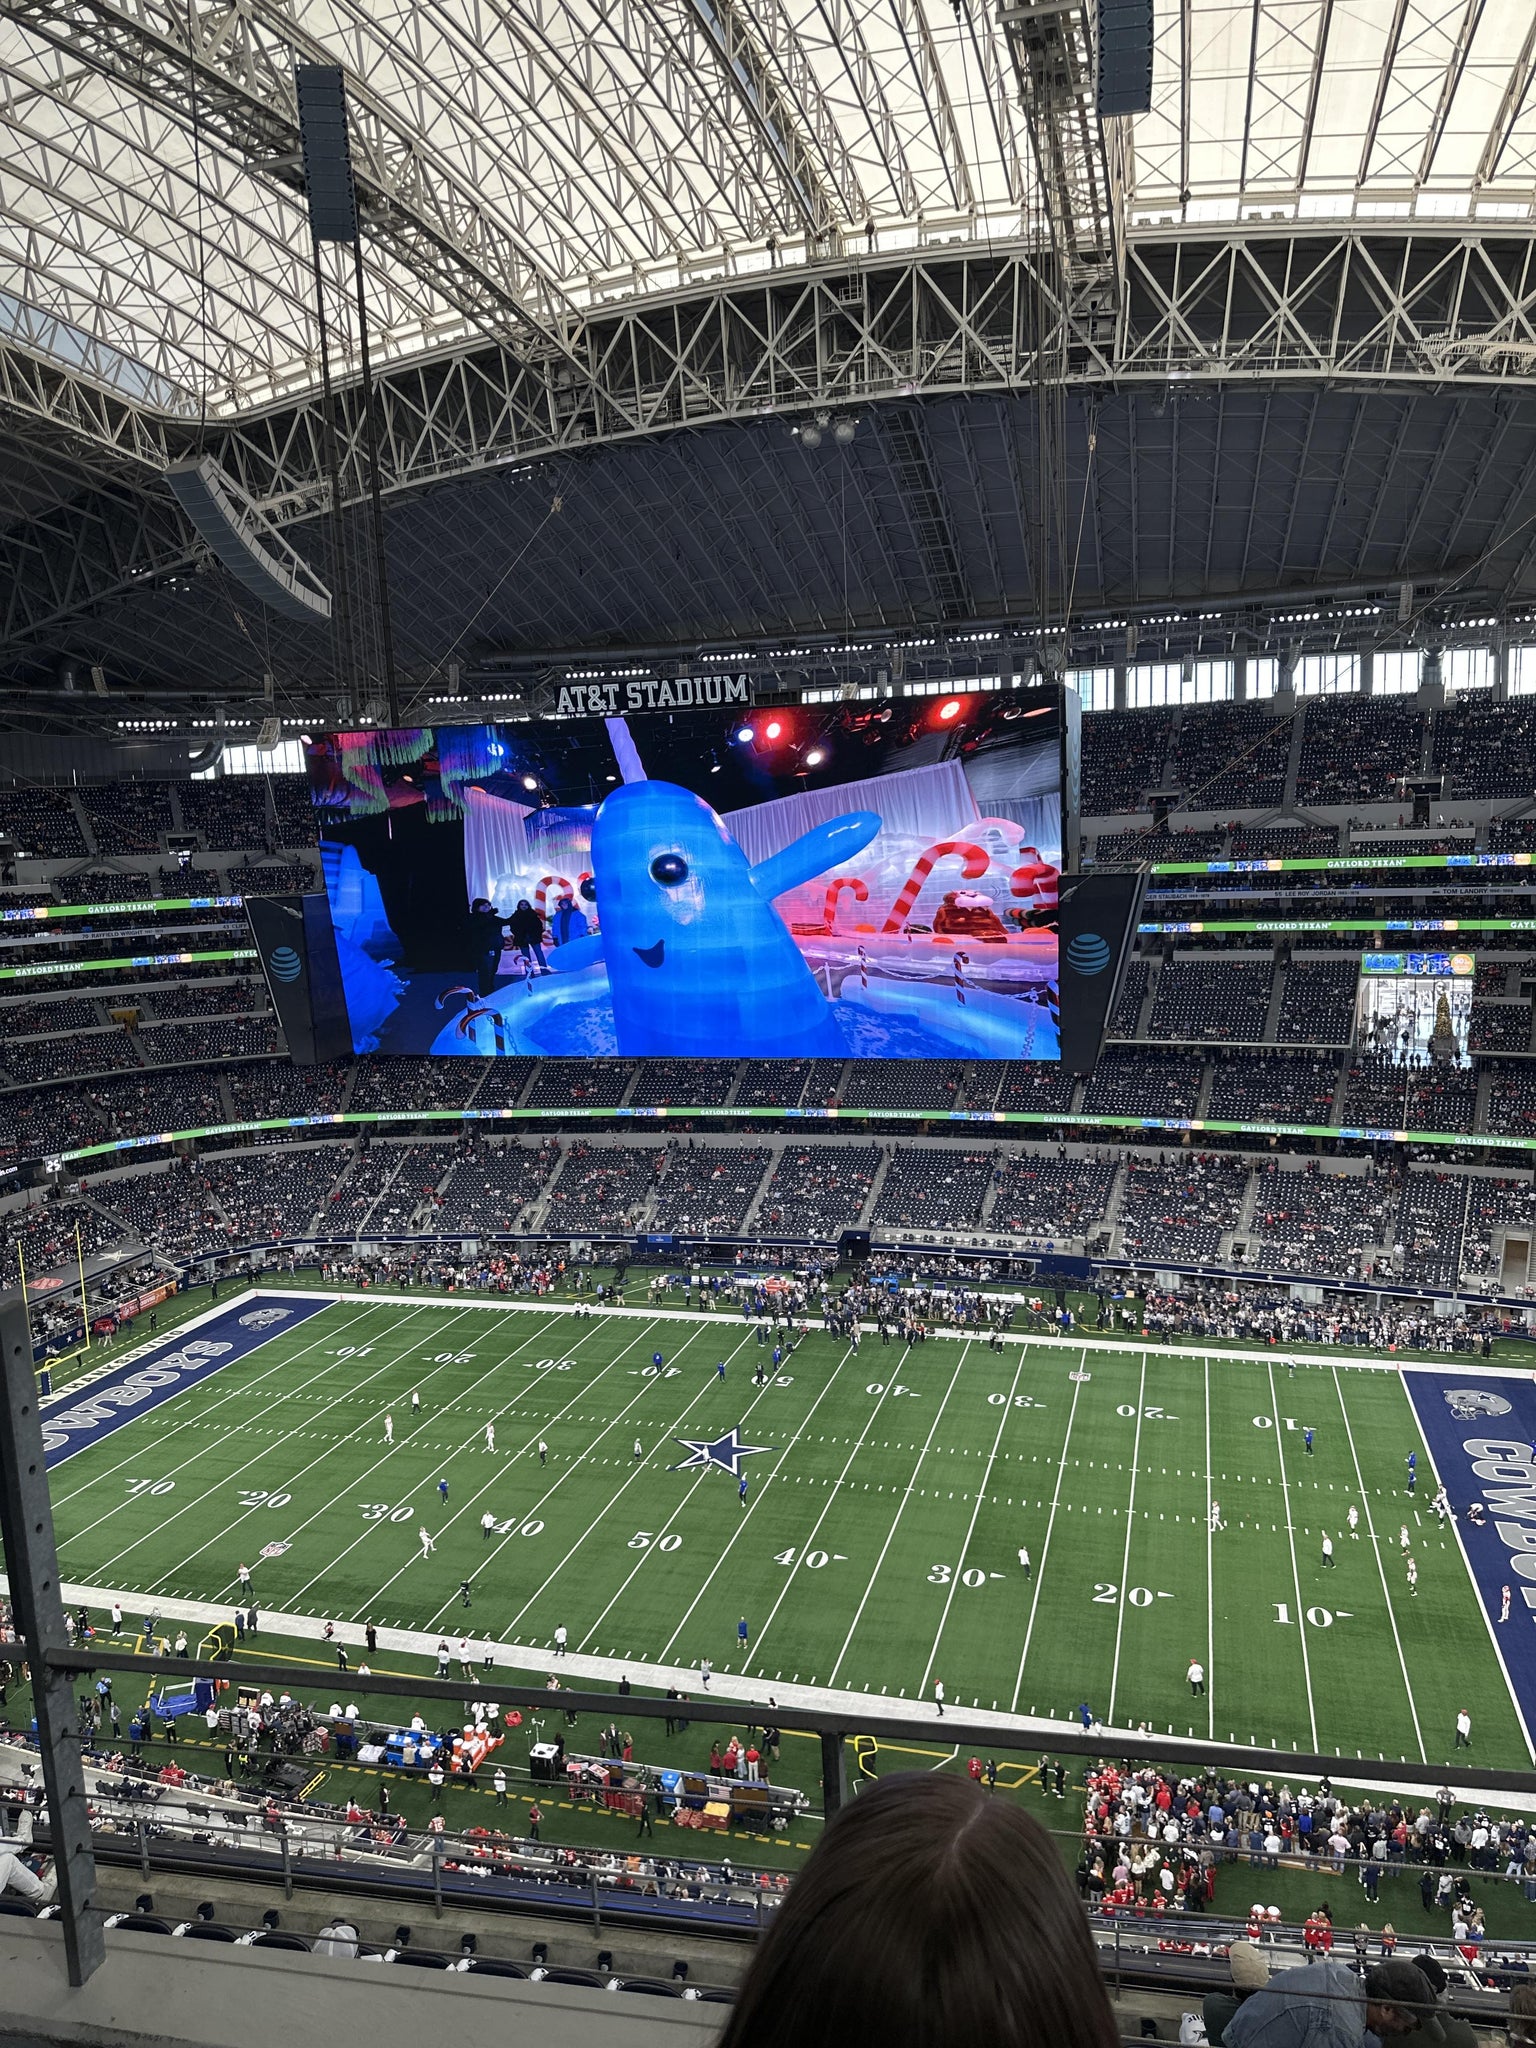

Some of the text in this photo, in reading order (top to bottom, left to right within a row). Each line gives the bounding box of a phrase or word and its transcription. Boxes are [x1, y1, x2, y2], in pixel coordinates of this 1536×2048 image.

[557, 675, 748, 713] AT&T STADIUM
[1327, 860, 1370, 868] GAYLORD
[88, 905, 126, 913] GAYLORD
[1256, 922, 1296, 930] GAYLORD
[16, 966, 53, 976] GAYLORD
[205, 1126, 236, 1135] GAYLORD
[1240, 1125, 1276, 1133] GAYLORD
[1455, 1137, 1494, 1146] GAYLORD
[47, 1159, 60, 1172] 25
[336, 1346, 376, 1357] 10
[434, 1352, 477, 1364] 20
[535, 1358, 577, 1371] 30
[641, 1365, 682, 1378] 40
[866, 1383, 910, 1396] 40
[987, 1393, 1033, 1407] 30
[1116, 1404, 1165, 1419] 20
[1252, 1416, 1299, 1430] 10
[126, 1478, 176, 1496] 10
[239, 1490, 293, 1509] 20
[362, 1503, 414, 1523] 30
[492, 1517, 545, 1537] 40
[627, 1531, 683, 1552] 50
[773, 1547, 829, 1569] 40
[926, 1564, 986, 1587] 30
[1091, 1583, 1154, 1607] 20
[1271, 1603, 1333, 1627] 10
